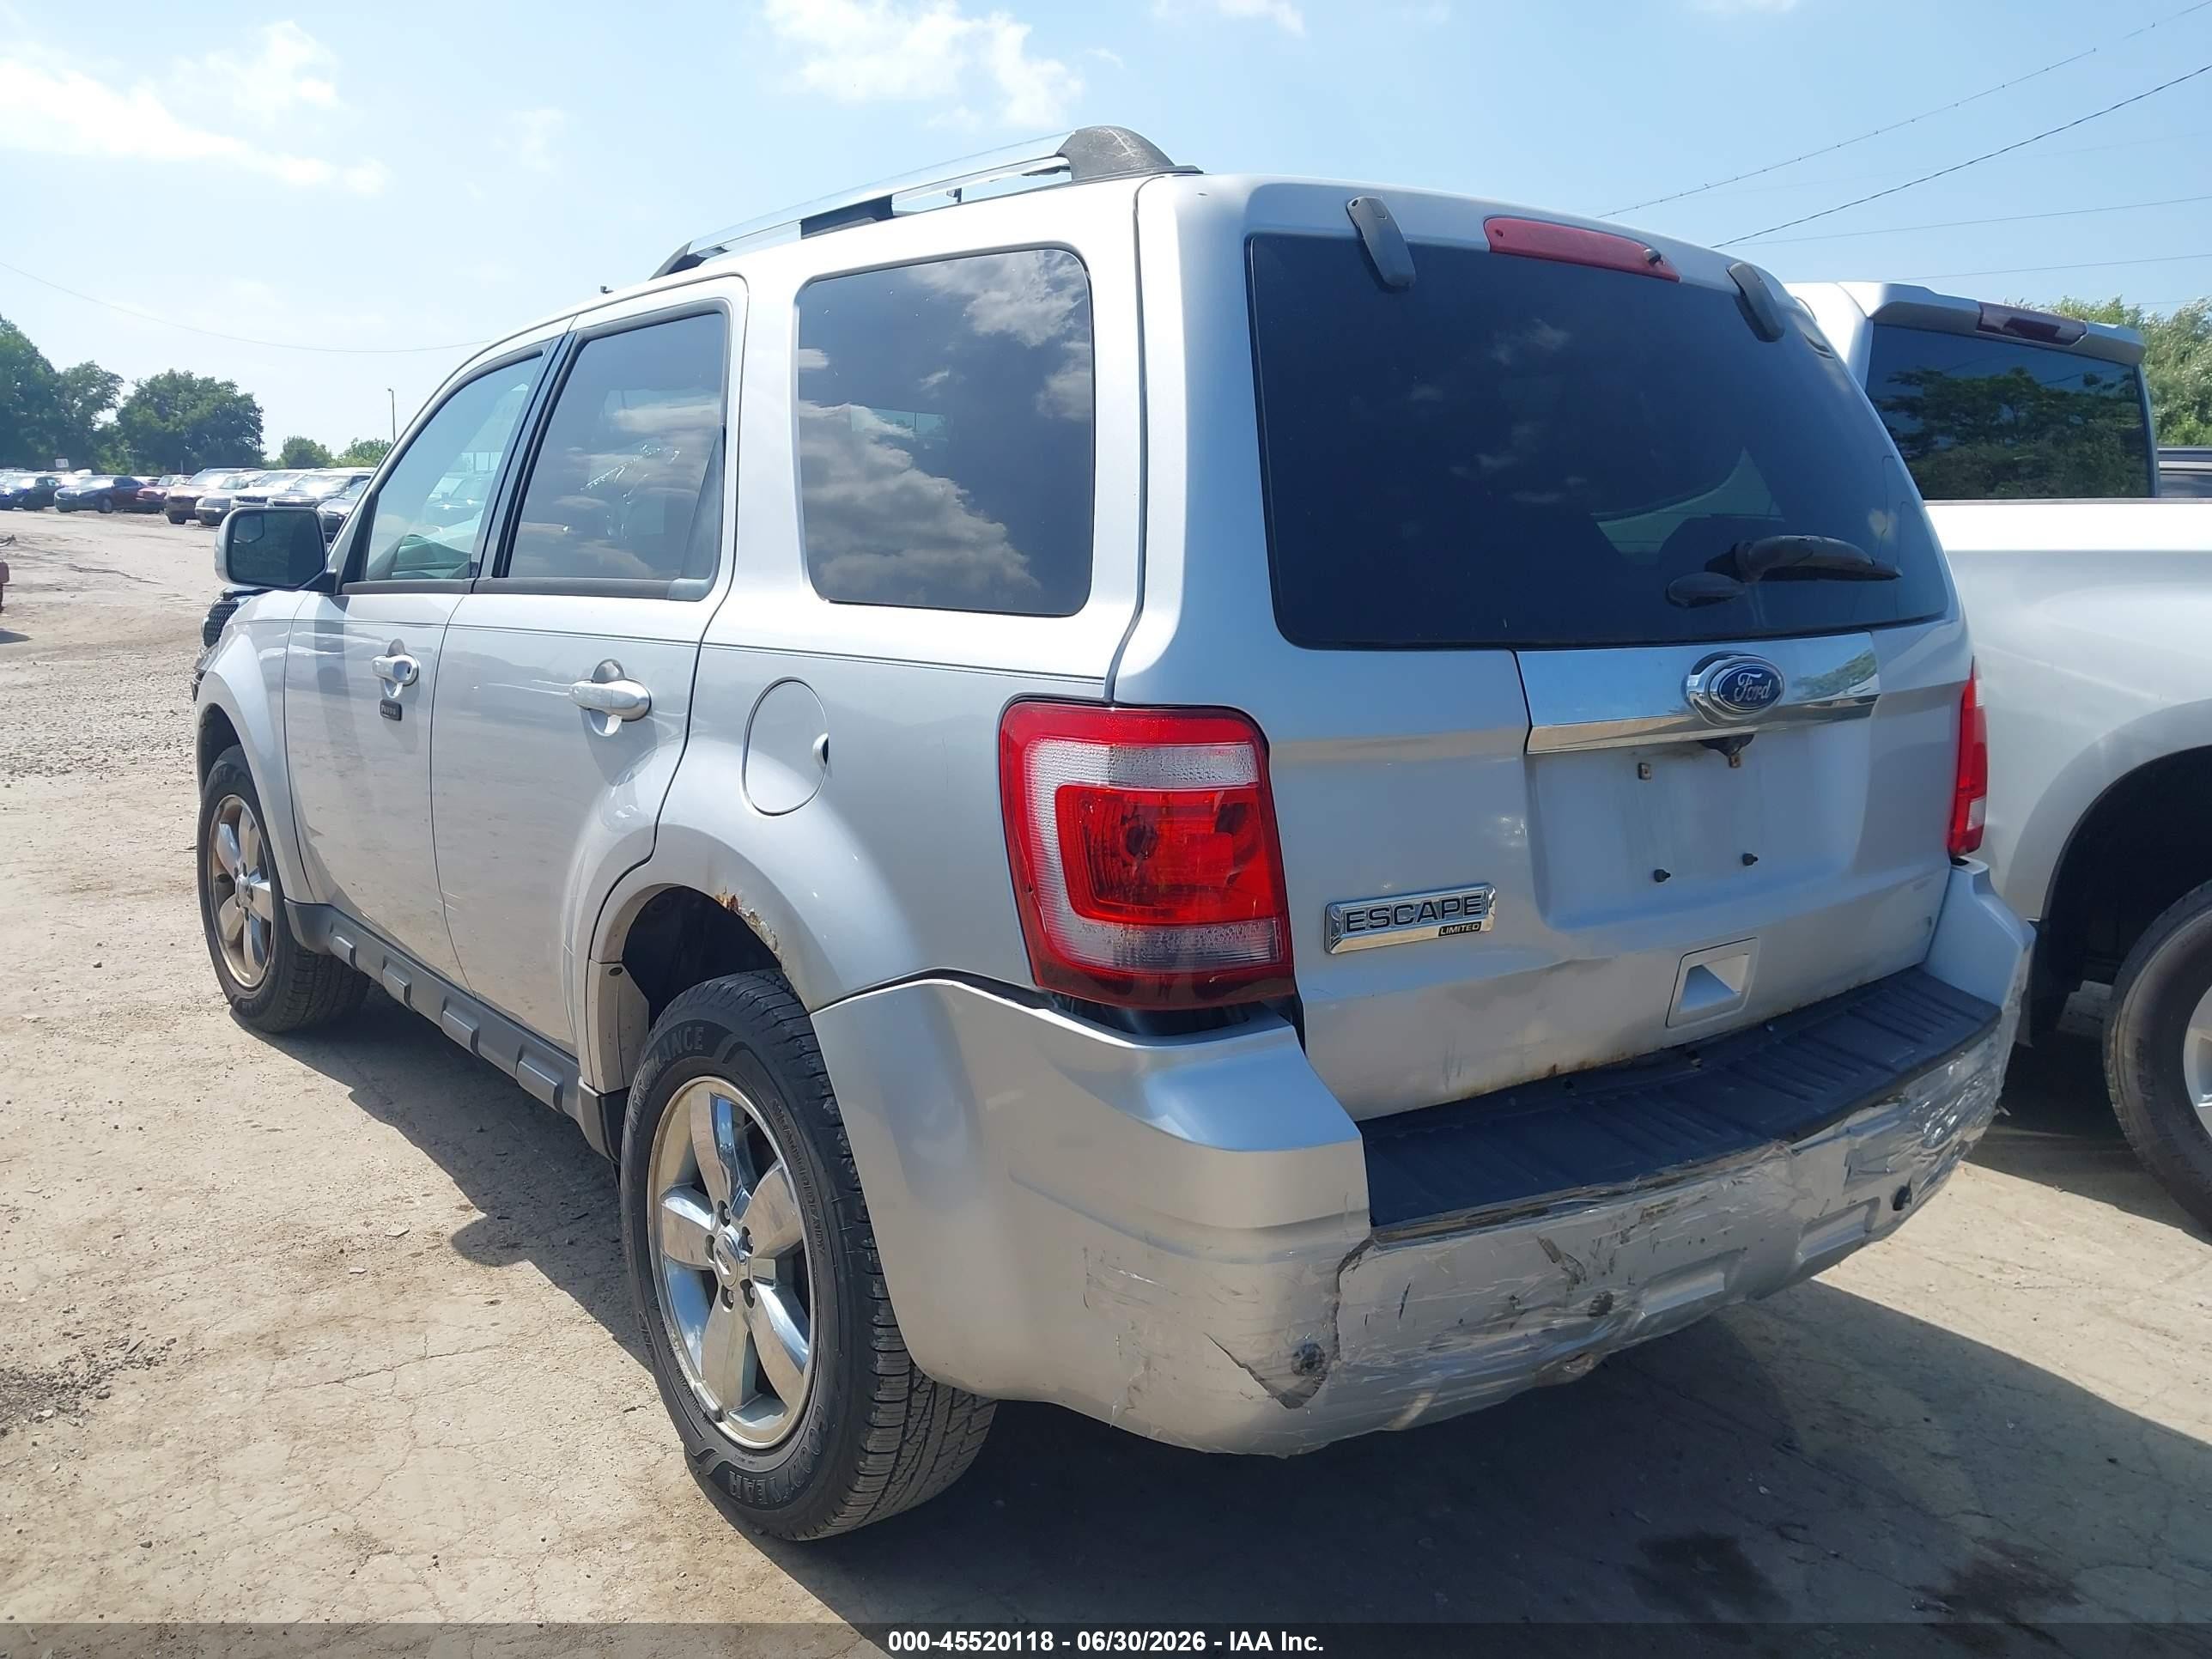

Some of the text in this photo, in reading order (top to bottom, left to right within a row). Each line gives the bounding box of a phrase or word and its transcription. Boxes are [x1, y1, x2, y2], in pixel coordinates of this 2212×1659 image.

[1733, 672, 1772, 702] Ford
[1346, 895, 1482, 933] ESCAPE
[1439, 923, 1480, 936] LIMITED
